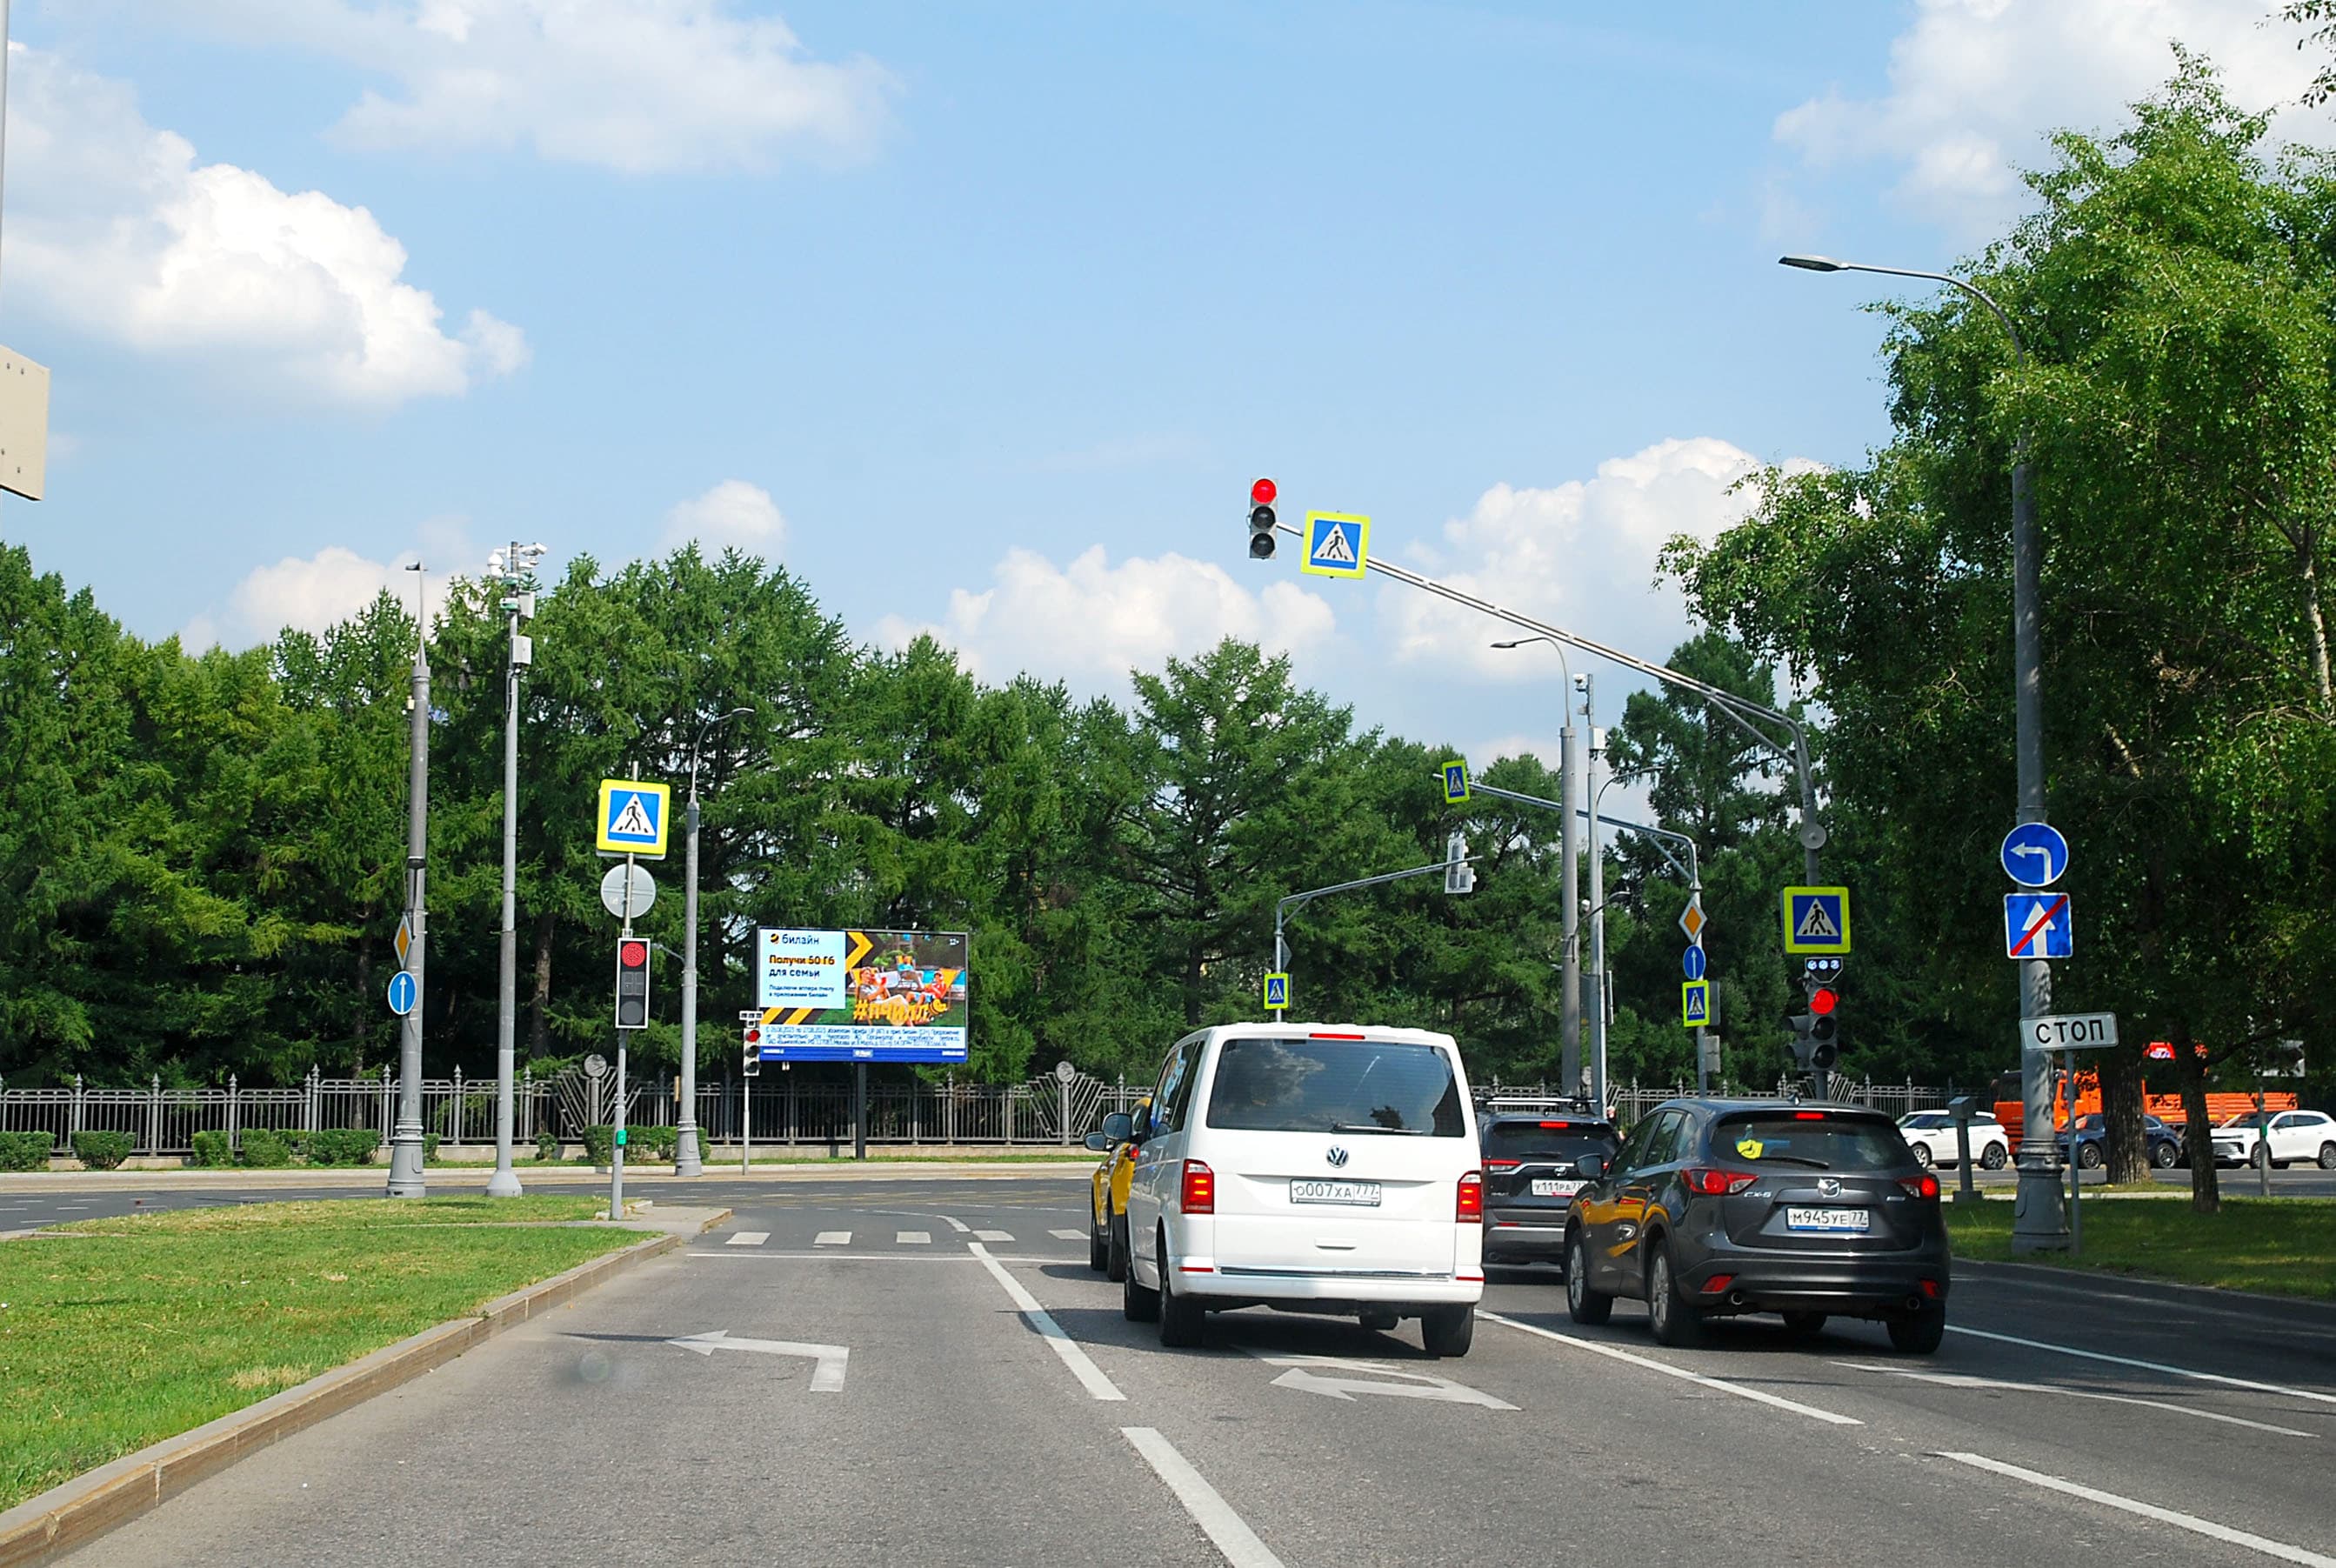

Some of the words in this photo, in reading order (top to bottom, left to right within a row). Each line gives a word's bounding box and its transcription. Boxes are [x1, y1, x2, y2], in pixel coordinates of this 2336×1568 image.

[782, 933, 819, 945] билайн
[769, 954, 806, 966] Получи
[769, 969, 787, 977] для
[789, 969, 820, 977] семьи
[2035, 1019, 2104, 1044] СТОП
